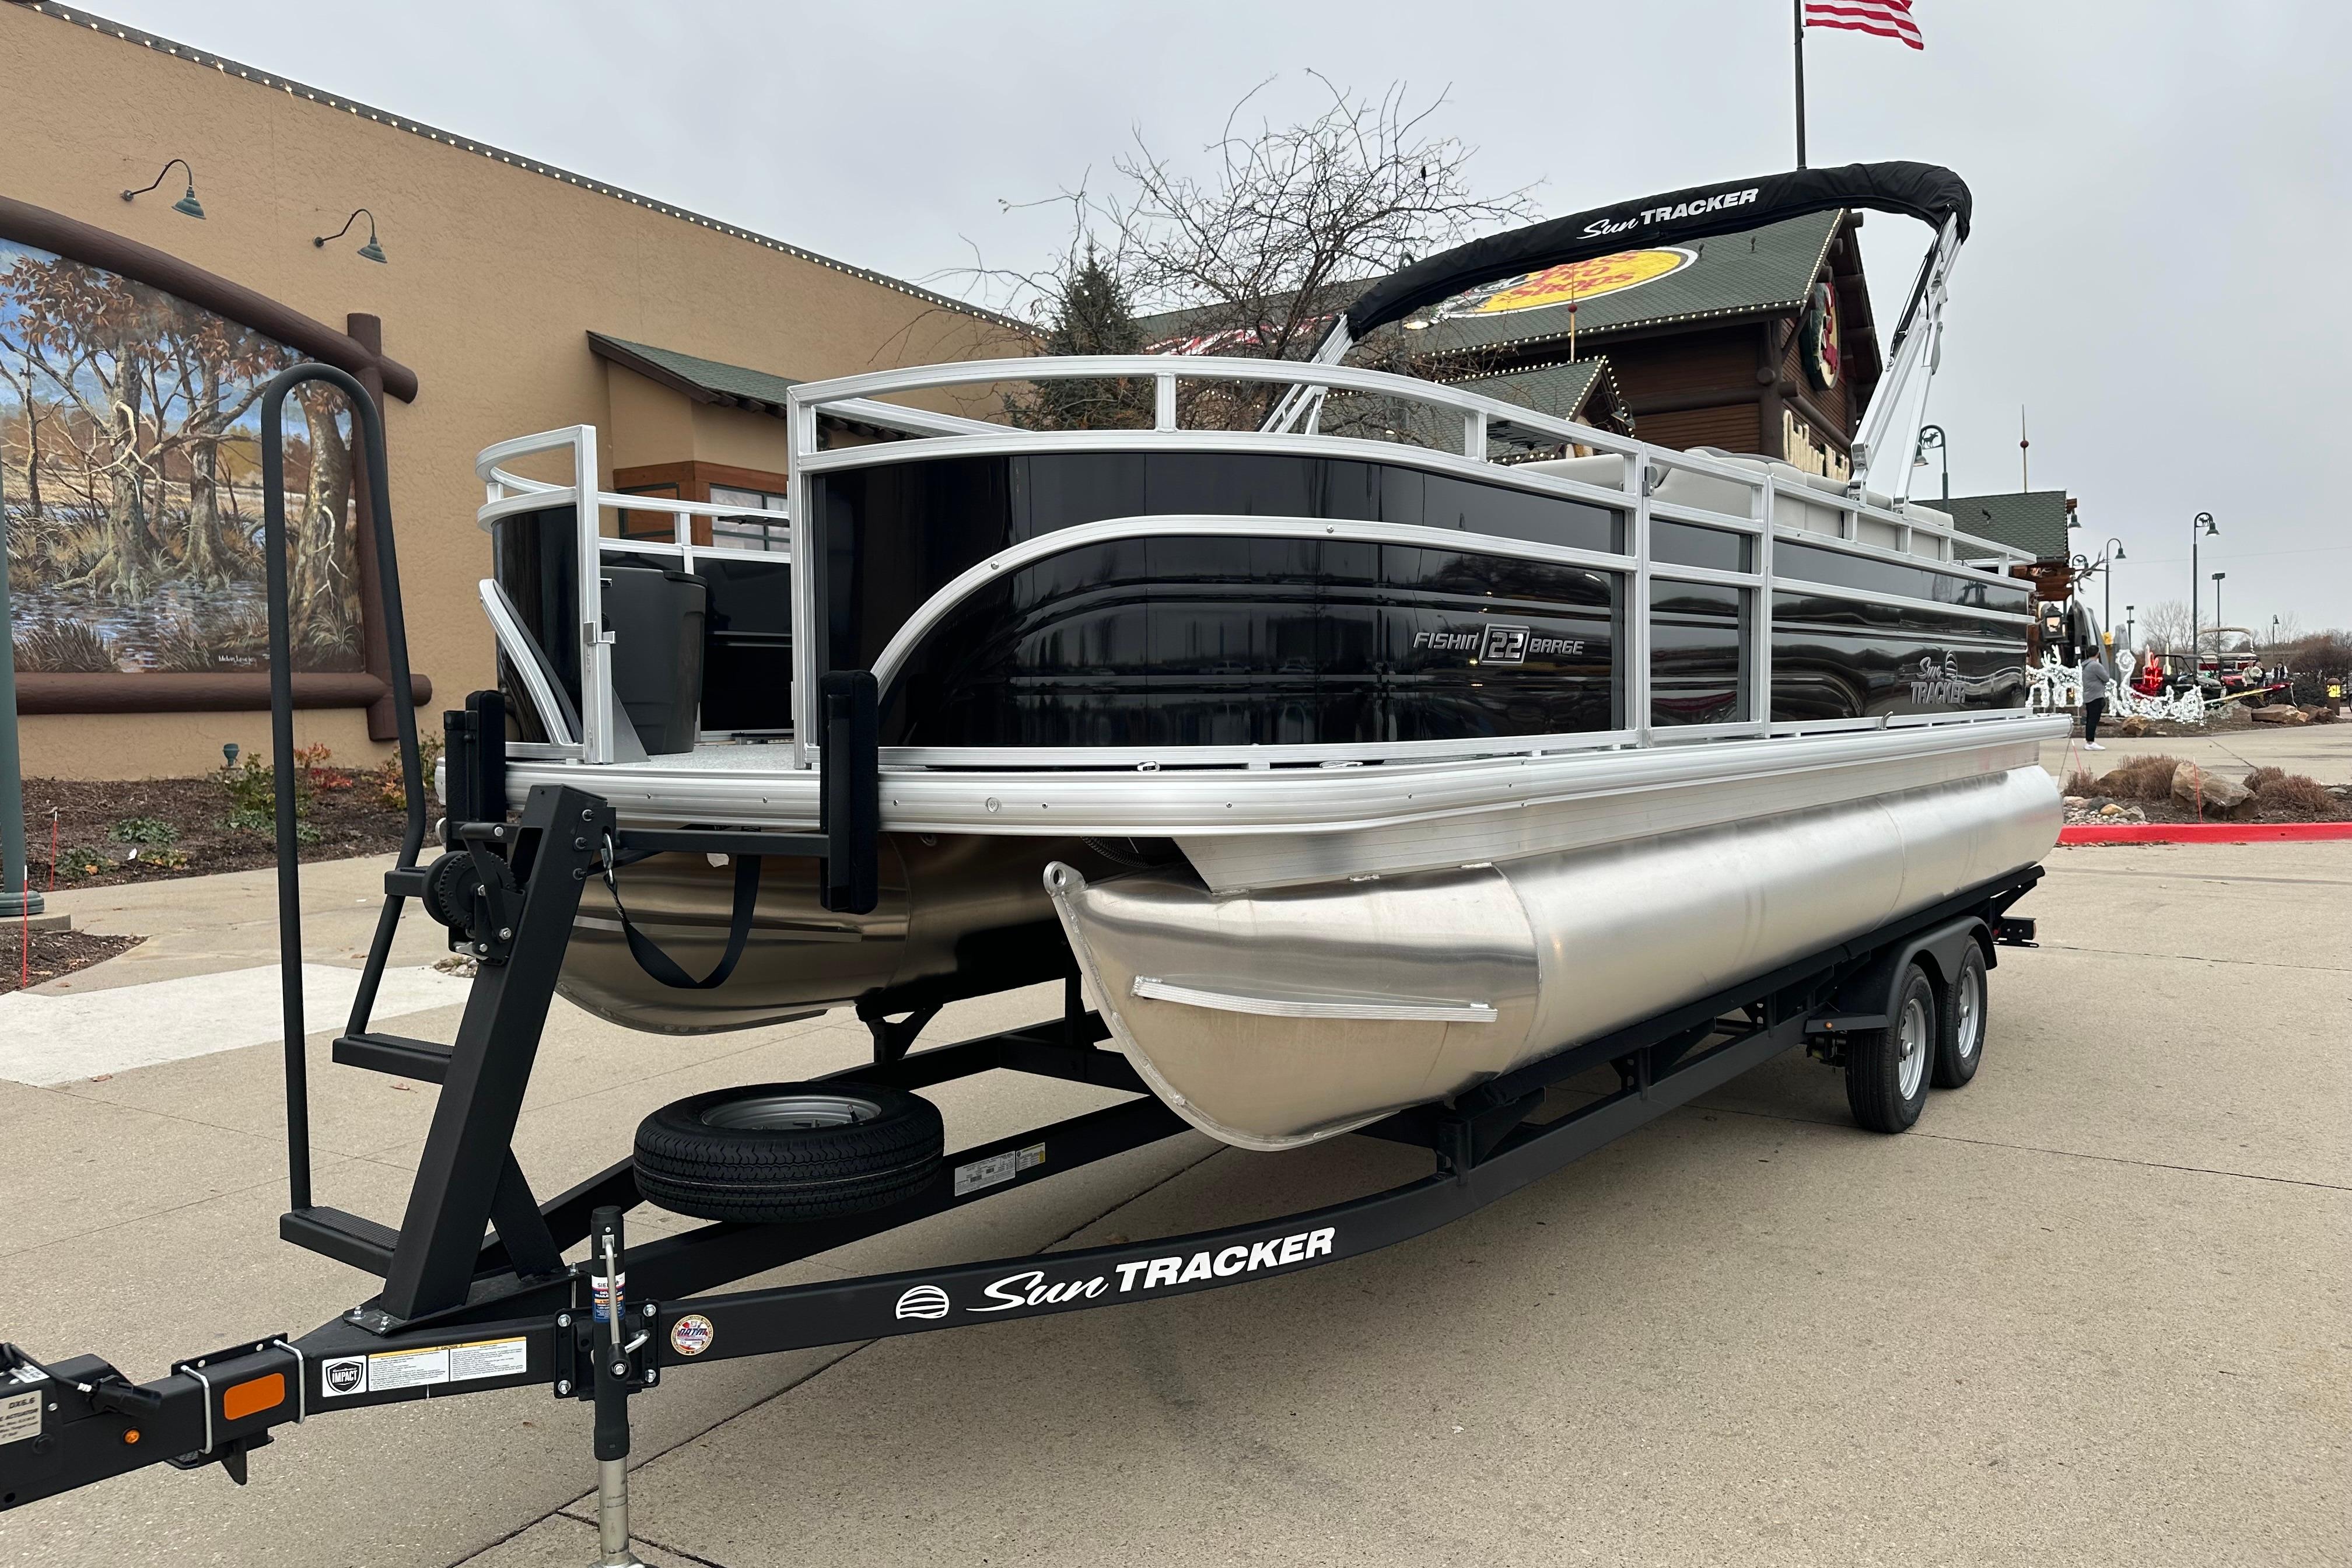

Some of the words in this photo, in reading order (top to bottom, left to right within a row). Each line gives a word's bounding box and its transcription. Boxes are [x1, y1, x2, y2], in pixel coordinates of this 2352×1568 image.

[1576, 217, 1640, 240] Sun
[1640, 188, 1759, 225] TRACKER
[1505, 272, 1634, 298] Shops
[1488, 631, 1524, 659] 22
[1529, 638, 1586, 656] BARGE
[1916, 656, 1943, 680] Sun
[1910, 681, 1966, 704] TRACKER
[965, 1270, 1109, 1312] Sun
[1115, 1227, 1336, 1293] TRACKER
[332, 1370, 358, 1383] IMPACT
